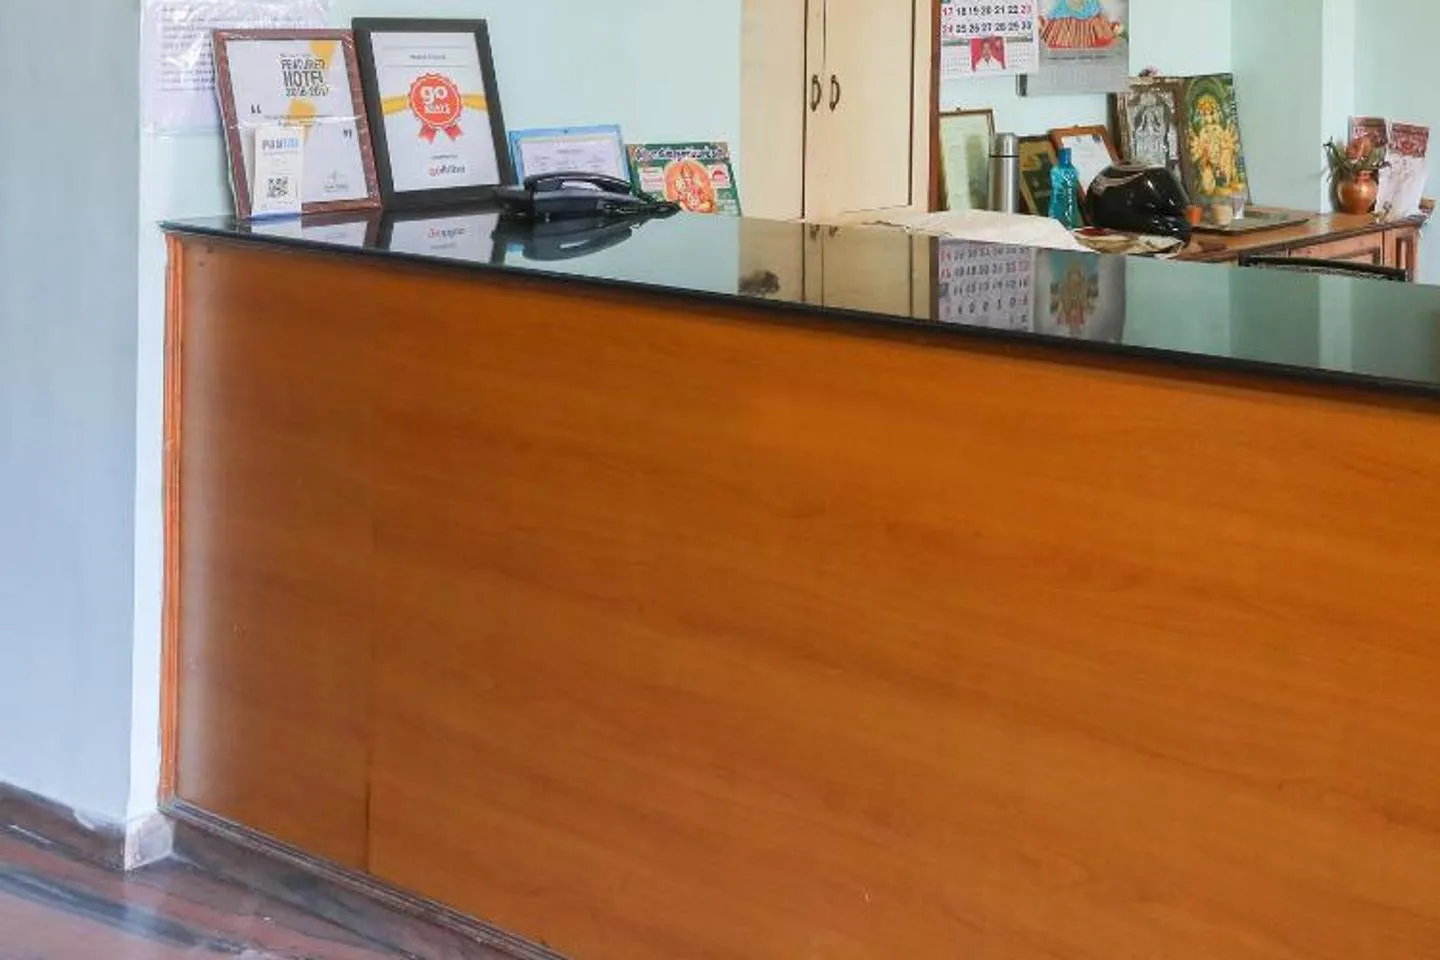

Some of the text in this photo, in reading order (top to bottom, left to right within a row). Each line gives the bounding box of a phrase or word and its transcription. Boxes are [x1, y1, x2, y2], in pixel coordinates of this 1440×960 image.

[943, 7, 953, 16] 17
[956, 7, 966, 16] 18
[969, 6, 979, 15] 19
[981, 5, 992, 15] 20
[994, 5, 1005, 14] 21
[1008, 5, 1018, 14] 22
[283, 70, 324, 87] HOTEL
